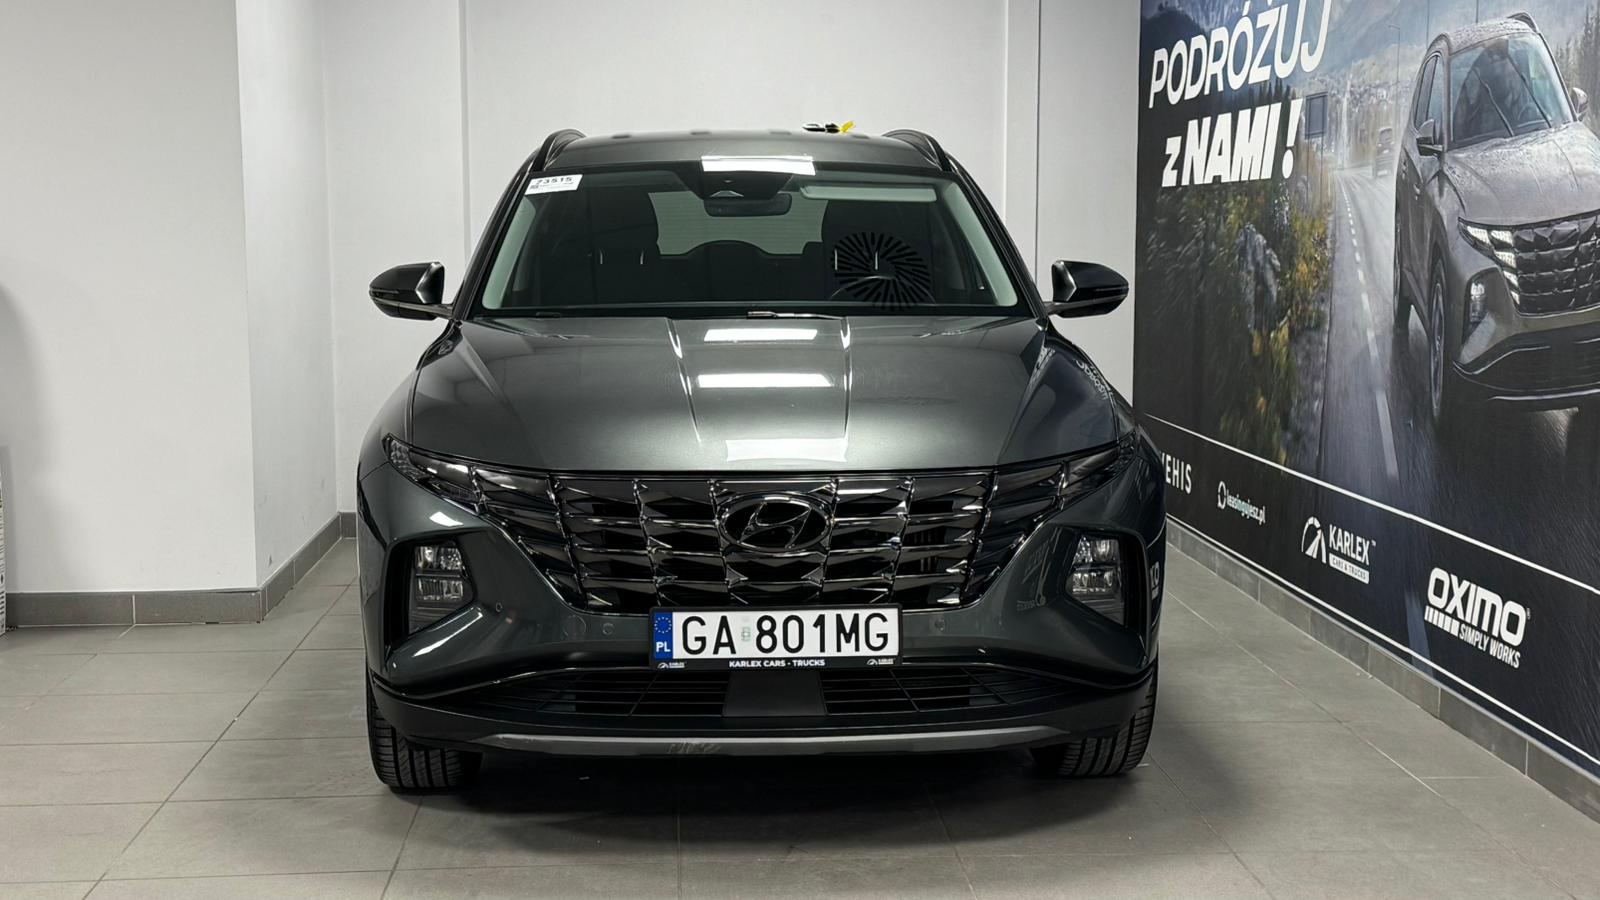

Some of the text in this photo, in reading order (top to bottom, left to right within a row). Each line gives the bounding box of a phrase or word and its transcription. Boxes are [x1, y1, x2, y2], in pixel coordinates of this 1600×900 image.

[1149, 0, 1331, 108] PODRÓŻUJ
[1162, 136, 1182, 187] z
[1329, 524, 1370, 566] KARLEX
[1427, 567, 1527, 647] OXIMO
[656, 642, 671, 653] PL
[681, 612, 889, 655] GA 801MG
[1460, 623, 1521, 669] SIMPLY WORKS
[729, 660, 762, 668] KARLEX
[792, 659, 826, 667] TRUCKS
